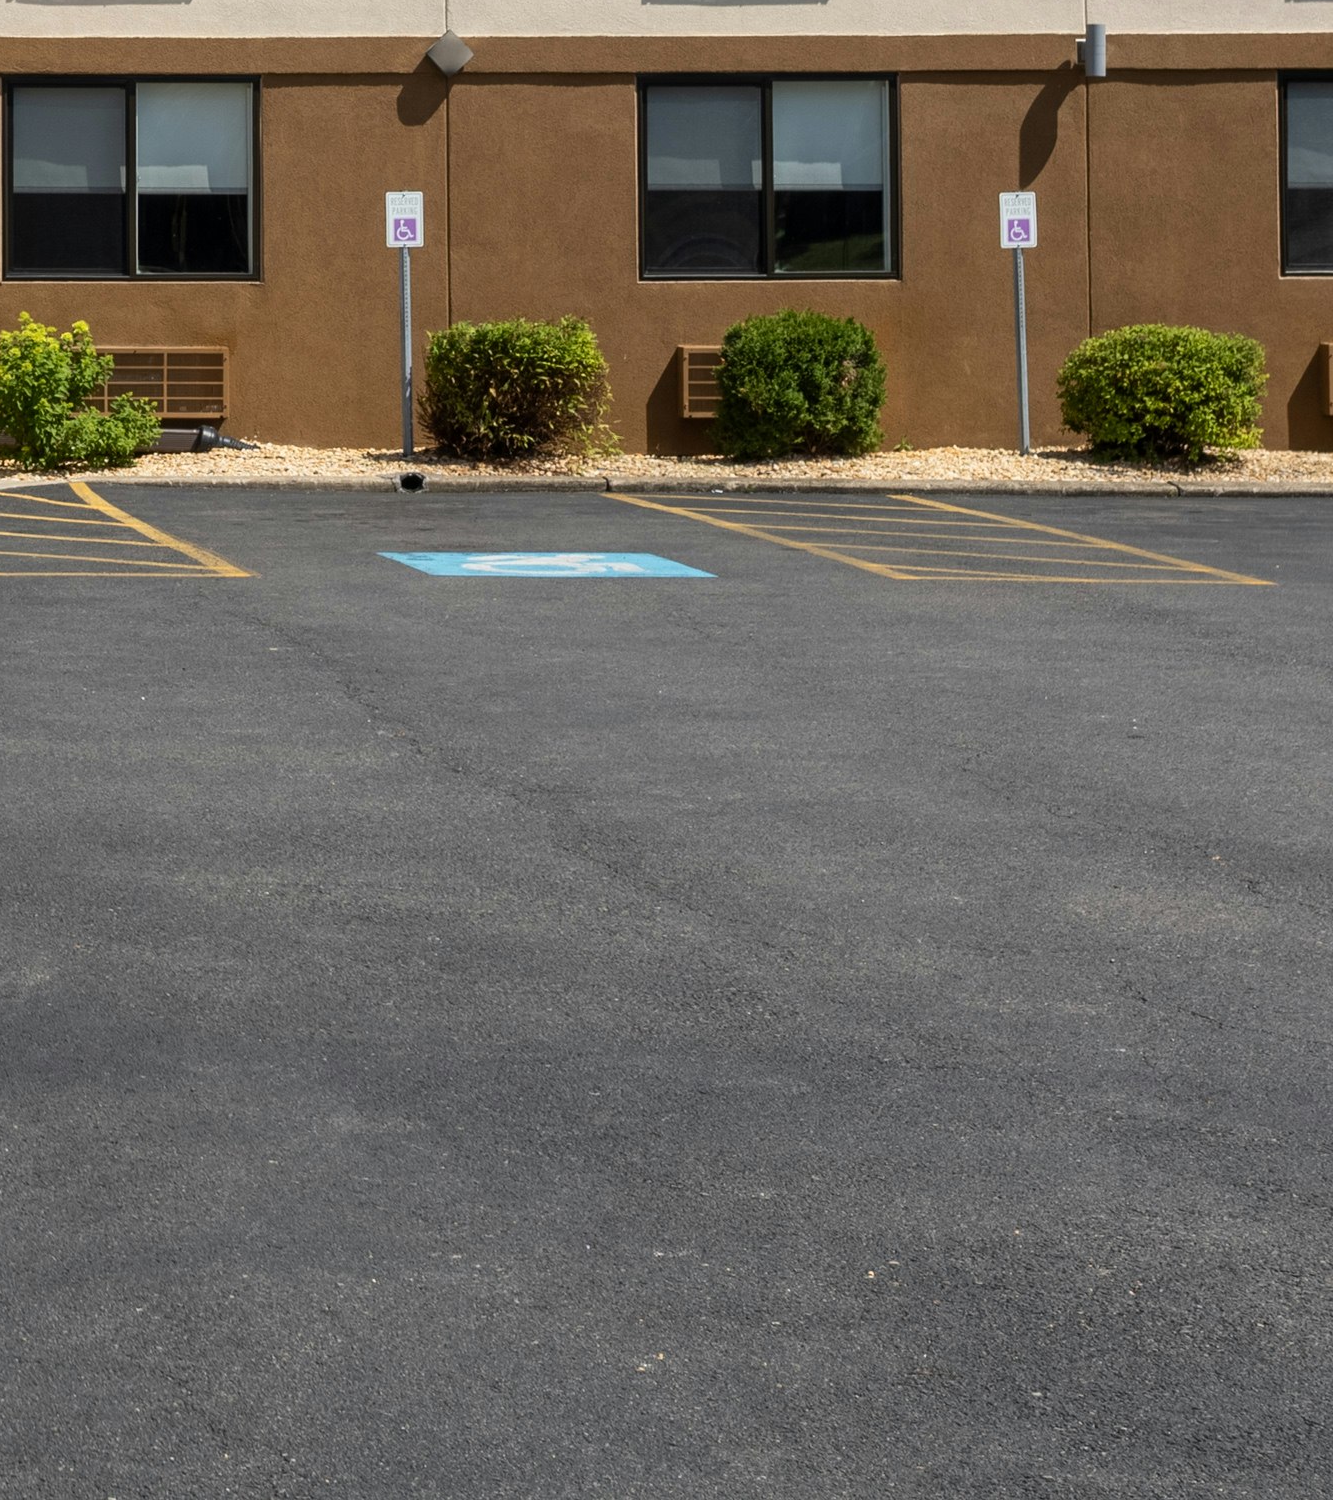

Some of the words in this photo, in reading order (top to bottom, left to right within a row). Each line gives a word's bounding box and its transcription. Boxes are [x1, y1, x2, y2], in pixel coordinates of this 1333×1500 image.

[390, 196, 419, 206] RESERVED
[1003, 197, 1031, 207] RESERVED
[392, 206, 418, 216] PARKING
[1005, 207, 1031, 216] PARKING
